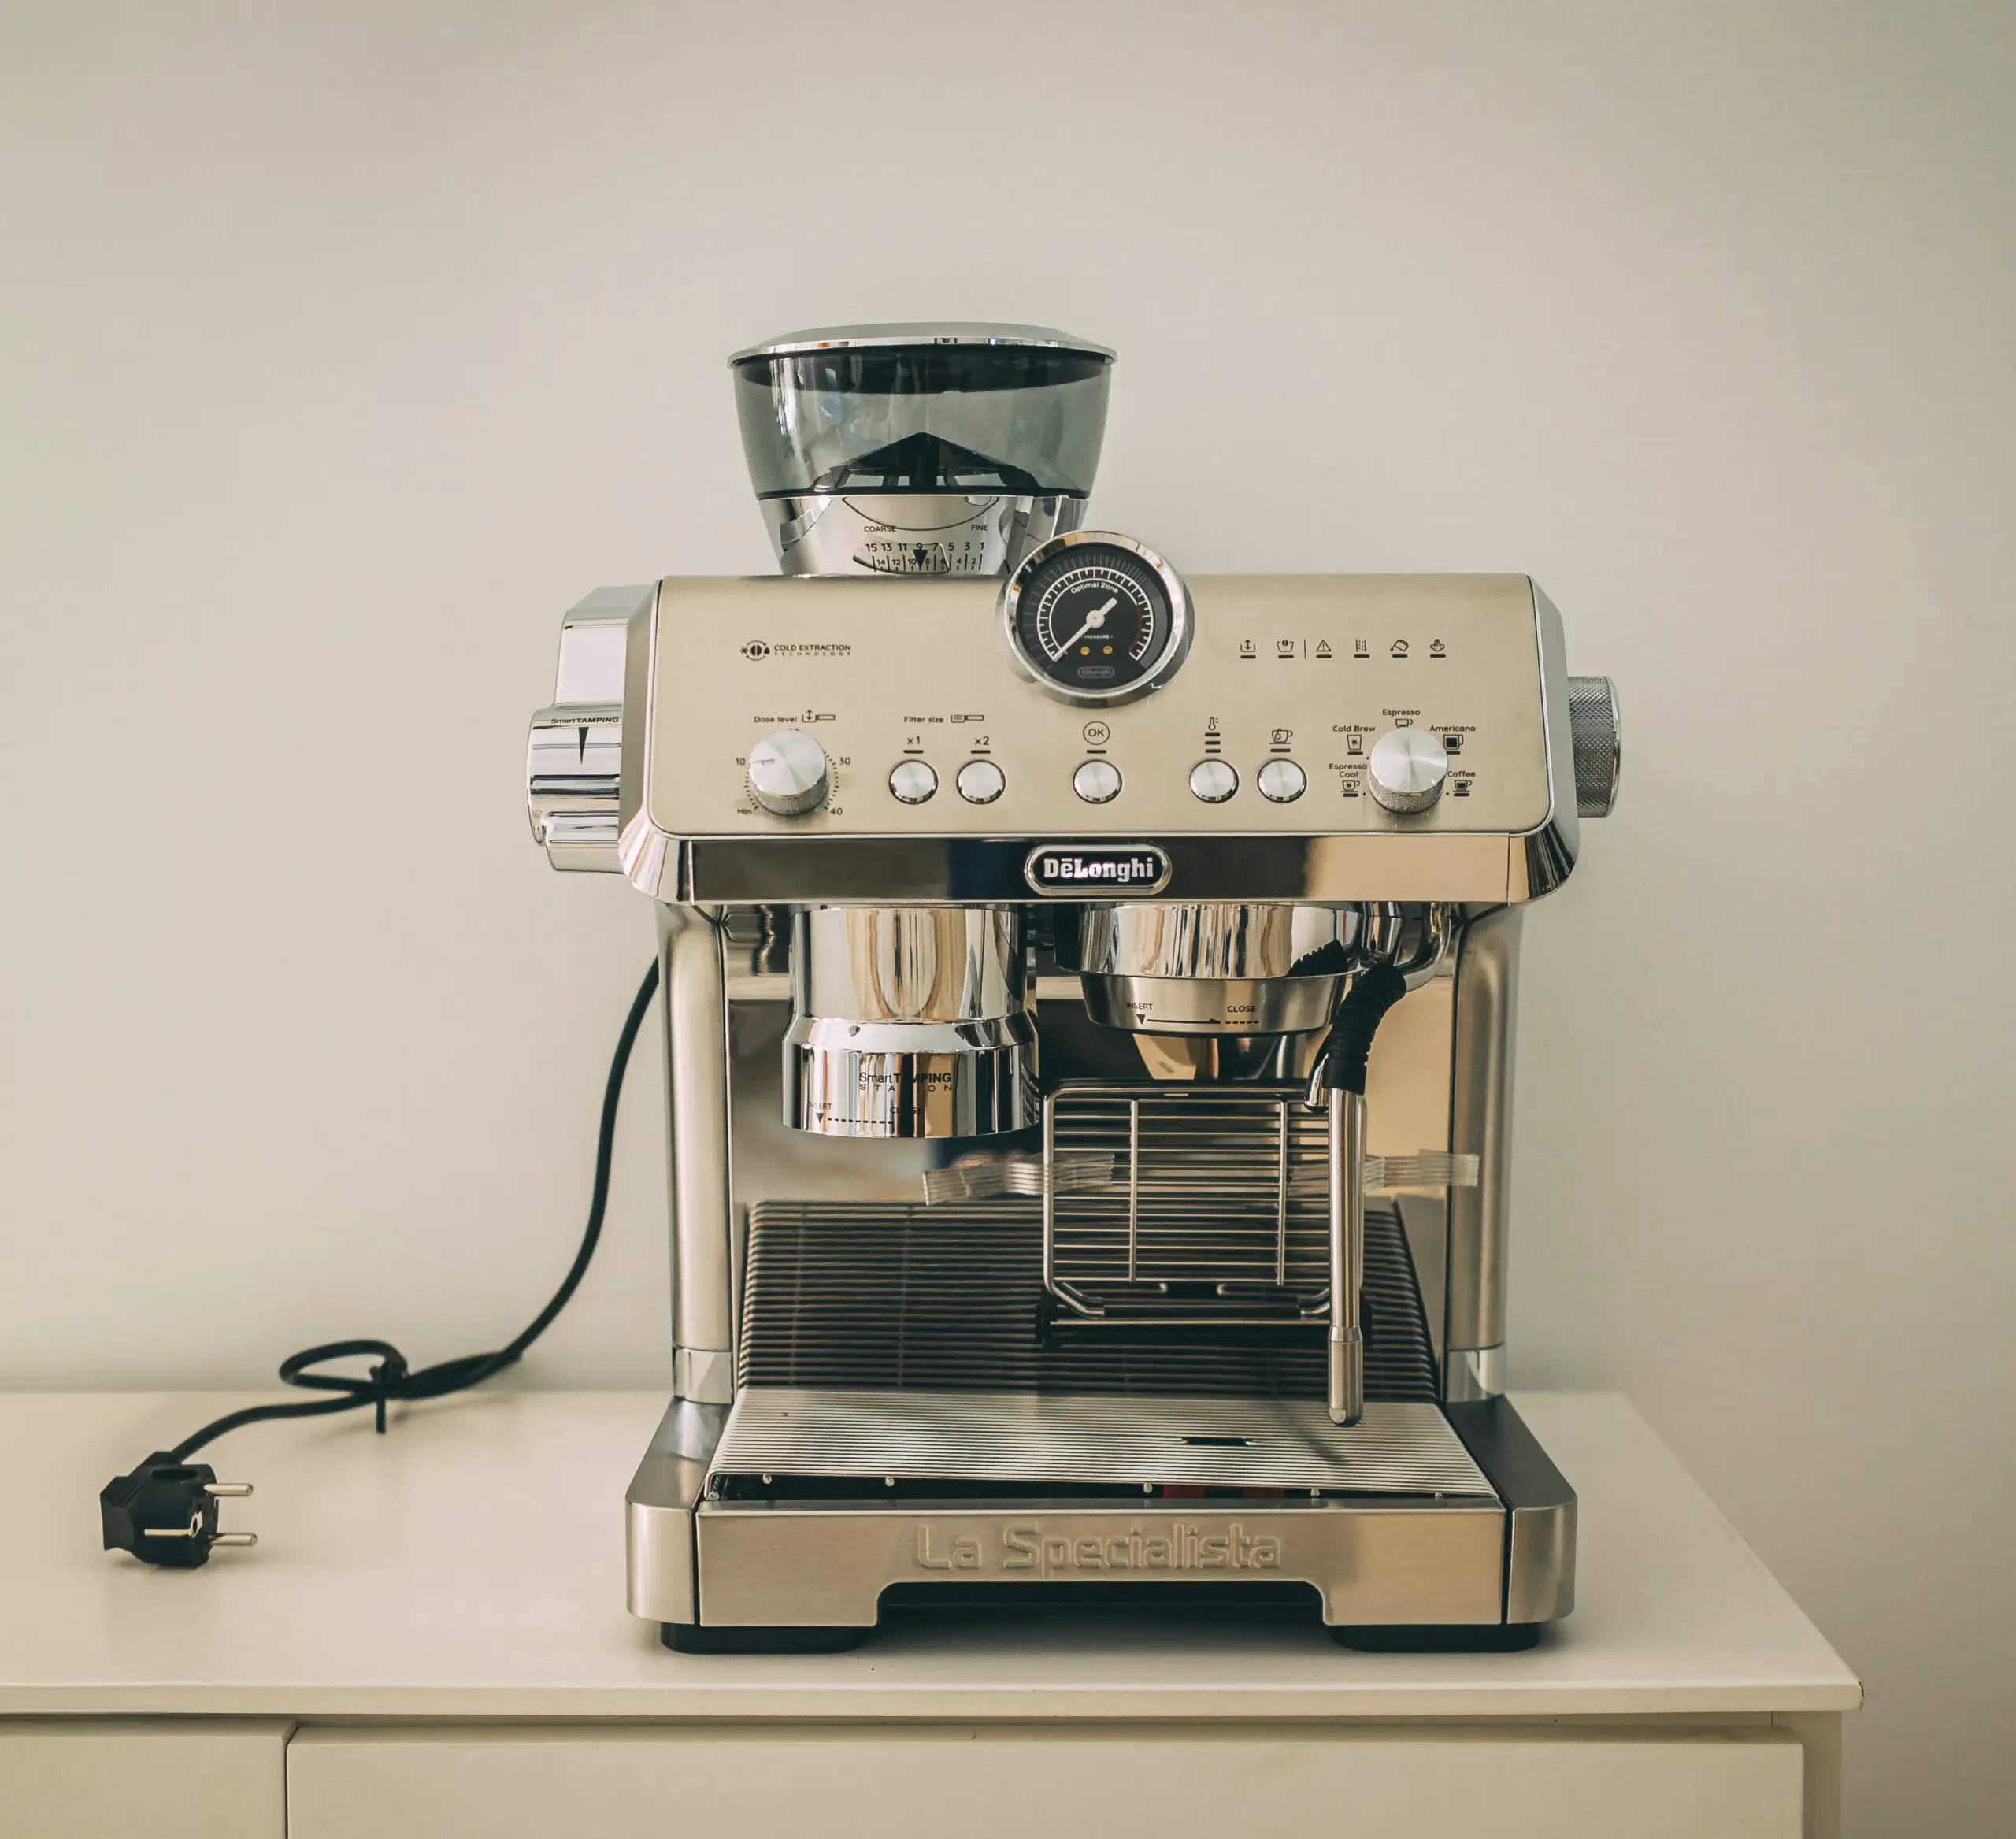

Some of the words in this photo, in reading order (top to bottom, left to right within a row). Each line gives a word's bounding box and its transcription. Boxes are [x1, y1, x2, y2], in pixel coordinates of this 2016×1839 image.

[866, 543, 878, 551] 15
[881, 543, 892, 551] 13
[898, 543, 907, 551] 11
[916, 542, 922, 551] 9
[932, 542, 939, 551] 7
[948, 542, 954, 551] 5
[964, 542, 970, 551] 3
[1071, 582, 1099, 594] Optimal
[1101, 582, 1119, 594] Zone
[1088, 729, 1105, 738] OK
[839, 757, 851, 766] 30
[830, 807, 843, 816] 40
[1126, 1002, 1153, 1010] INSERT
[808, 1101, 832, 1110] NSERT
[917, 1524, 983, 1570] La
[1002, 1522, 1282, 1578] Specialista
